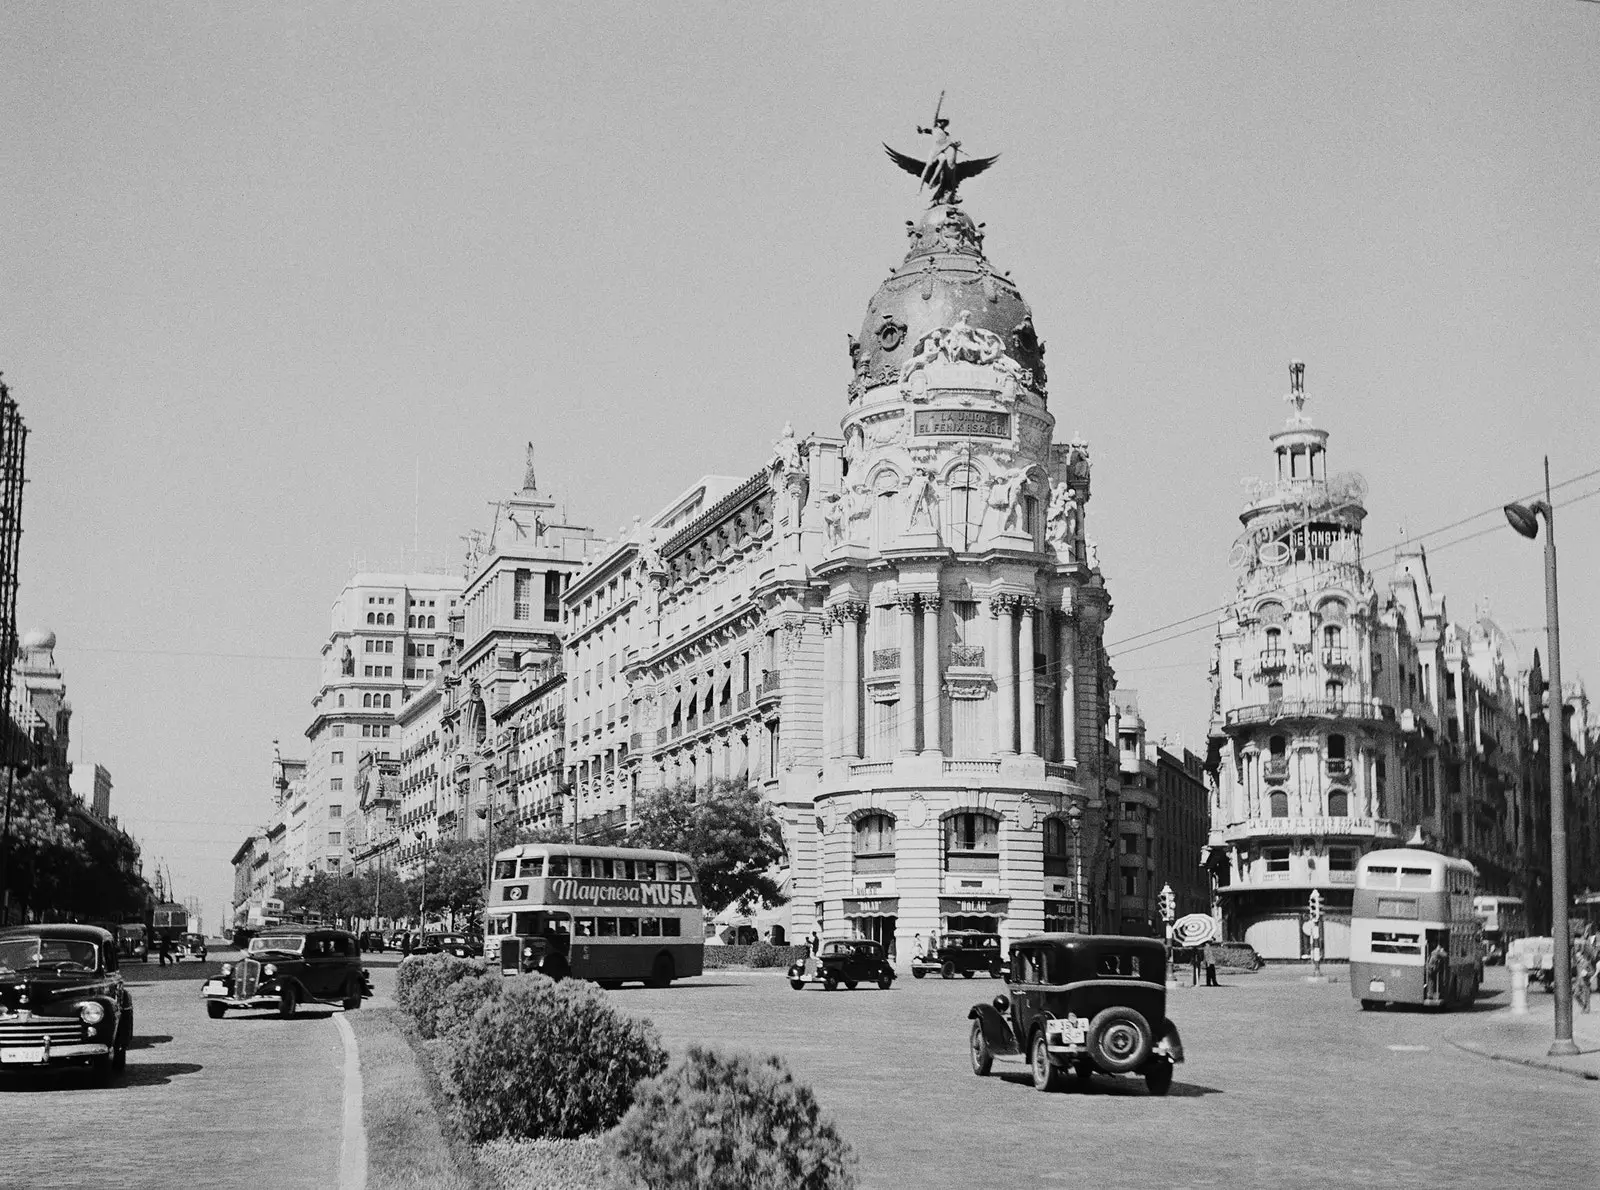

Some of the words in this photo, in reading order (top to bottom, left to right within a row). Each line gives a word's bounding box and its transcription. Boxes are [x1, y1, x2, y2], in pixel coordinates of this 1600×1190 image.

[941, 412, 954, 422] LA
[919, 424, 930, 434] EL
[552, 878, 640, 906] Mayonesa
[640, 882, 698, 905] MUSA
